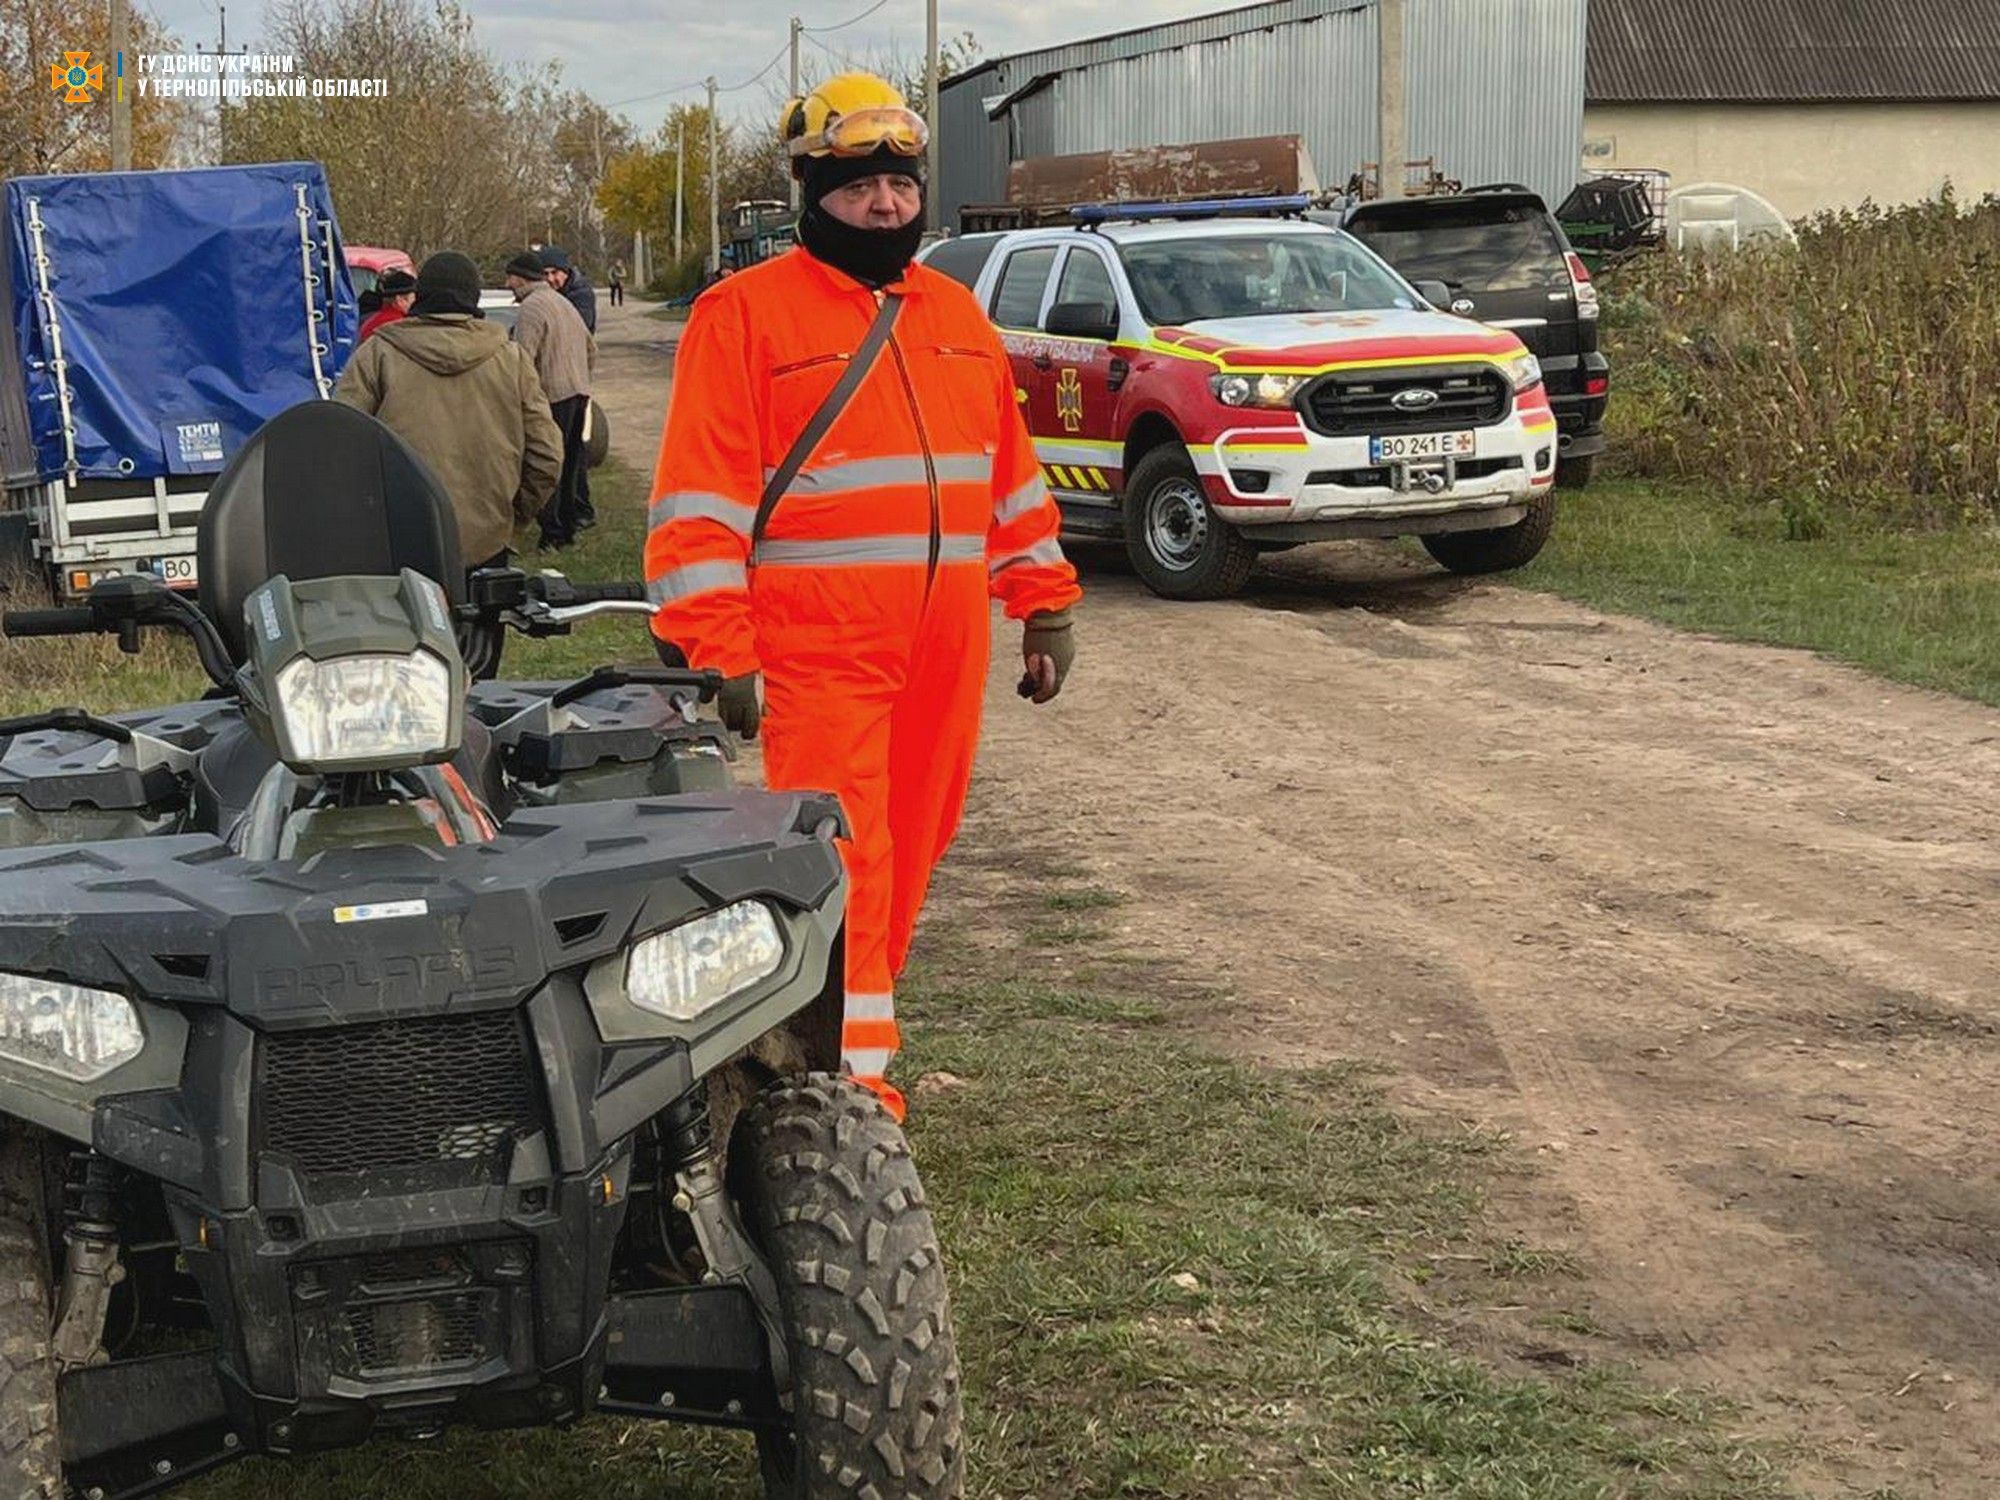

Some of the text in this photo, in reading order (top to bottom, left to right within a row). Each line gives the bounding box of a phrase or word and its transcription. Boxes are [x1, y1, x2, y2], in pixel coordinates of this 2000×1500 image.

[1382, 435, 1453, 457] BO 241 E
